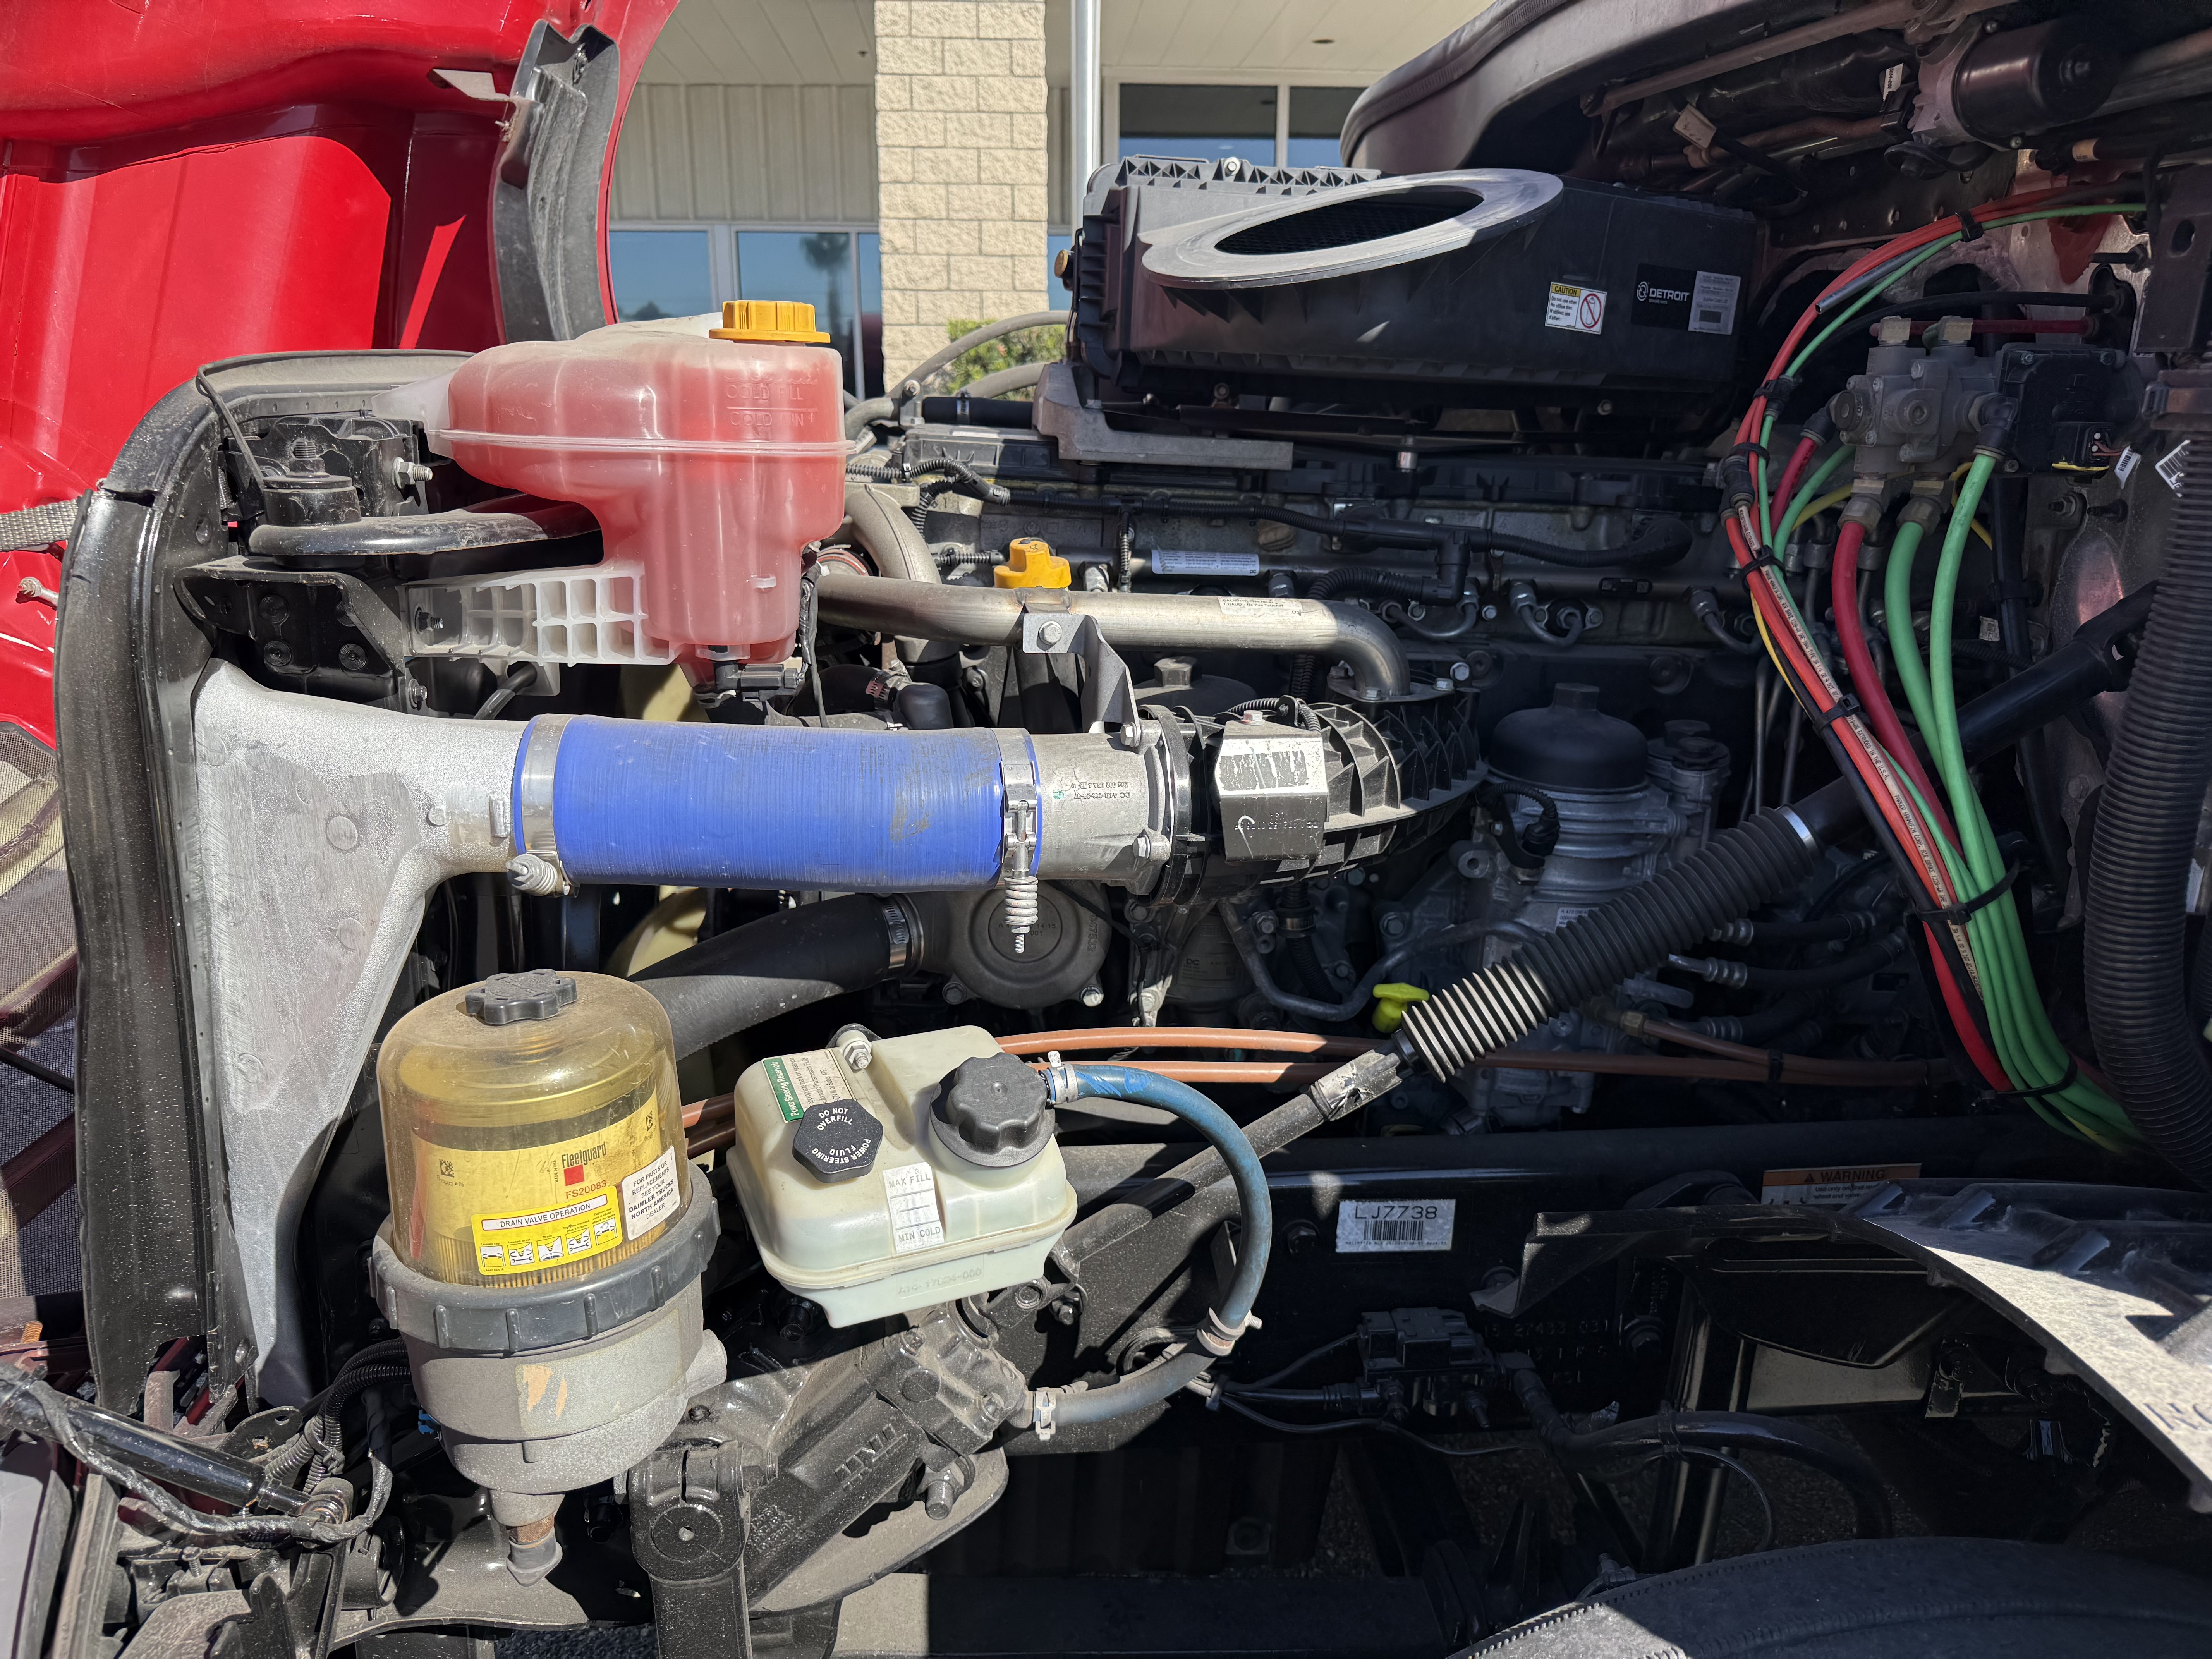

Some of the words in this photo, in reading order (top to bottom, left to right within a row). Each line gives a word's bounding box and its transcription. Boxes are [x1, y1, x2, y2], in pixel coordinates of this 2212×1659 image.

[1554, 286, 1577, 295] CAUTION
[1649, 287, 1690, 302] DETROIT
[726, 383, 769, 400] COLD
[778, 385, 804, 400] FILL
[730, 411, 772, 426] COLD
[780, 412, 804, 427] MIN
[1856, 729, 1872, 749] EXTRUDED
[1872, 756, 1882, 766] THE
[1877, 764, 1890, 780] U.S.A.
[1087, 914, 1098, 952] 047532
[771, 1061, 785, 1082] Reservoir
[824, 1075, 834, 1087] Super
[780, 1082, 794, 1103] Steering
[801, 1085, 814, 1104] appropriate
[788, 1101, 799, 1117] Power
[818, 1110, 830, 1119] DO
[817, 1115, 853, 1130] OVERFILL
[561, 1141, 607, 1169] Fleetguard
[812, 1148, 850, 1164] STEERING
[829, 1144, 857, 1156] FLUID
[850, 1139, 871, 1160] POWER
[632, 1167, 670, 1195] REPLACEMENTS
[633, 1176, 645, 1187] FOR
[646, 1166, 661, 1180] PARTS
[661, 1160, 668, 1168] OR
[889, 1178, 907, 1188] MAX
[910, 1173, 931, 1184] FILL
[1821, 1169, 1886, 1182] WARNING
[565, 1179, 607, 1199] FS20083
[629, 1194, 655, 1213] DAIMLER
[656, 1179, 674, 1197] TRUCKS
[641, 1188, 651, 1198] SEE
[653, 1178, 665, 1191] YOUR
[631, 1204, 653, 1220] NORTH
[653, 1187, 674, 1207] AMERICA
[646, 1202, 665, 1219] DEALER
[500, 1218, 523, 1228] DRAIN
[525, 1214, 548, 1224] VALVE
[550, 1202, 591, 1219] OPERATION
[1355, 1206, 1437, 1219] LJ7738
[898, 1231, 915, 1242] MIN
[920, 1226, 941, 1238] COLD
